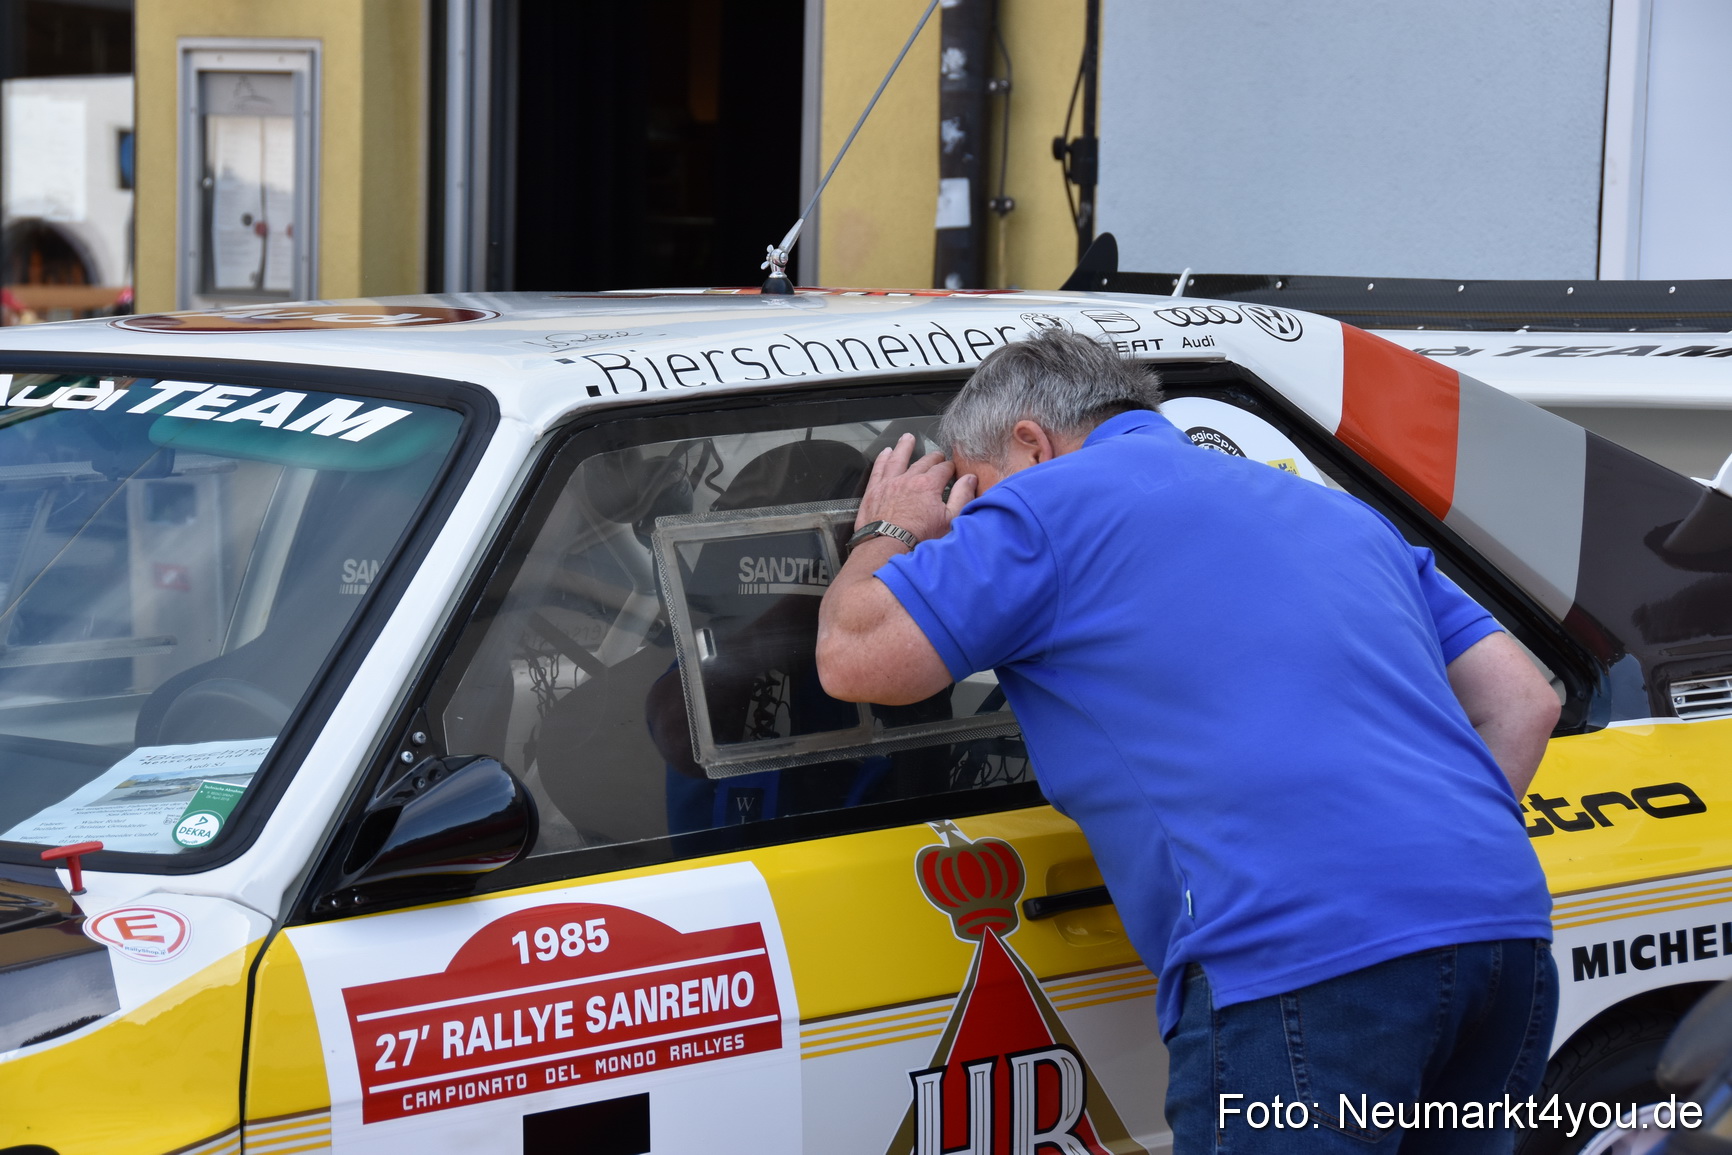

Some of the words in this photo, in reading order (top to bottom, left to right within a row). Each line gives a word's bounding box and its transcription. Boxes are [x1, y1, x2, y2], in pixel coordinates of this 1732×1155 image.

[581, 321, 1015, 395] Bierschneider
[1181, 334, 1215, 349] Audi
[126, 380, 413, 443] TEAM
[179, 826, 211, 838] DEKRA
[113, 914, 165, 943] E
[511, 918, 610, 965] 1985
[442, 1001, 574, 1059] RALLYE
[585, 971, 755, 1034] SANREMO
[402, 1073, 528, 1111] CAMPIONATO
[545, 1065, 581, 1085] DEL
[595, 1049, 657, 1076] MONDO
[669, 1033, 746, 1062] RALLYES
